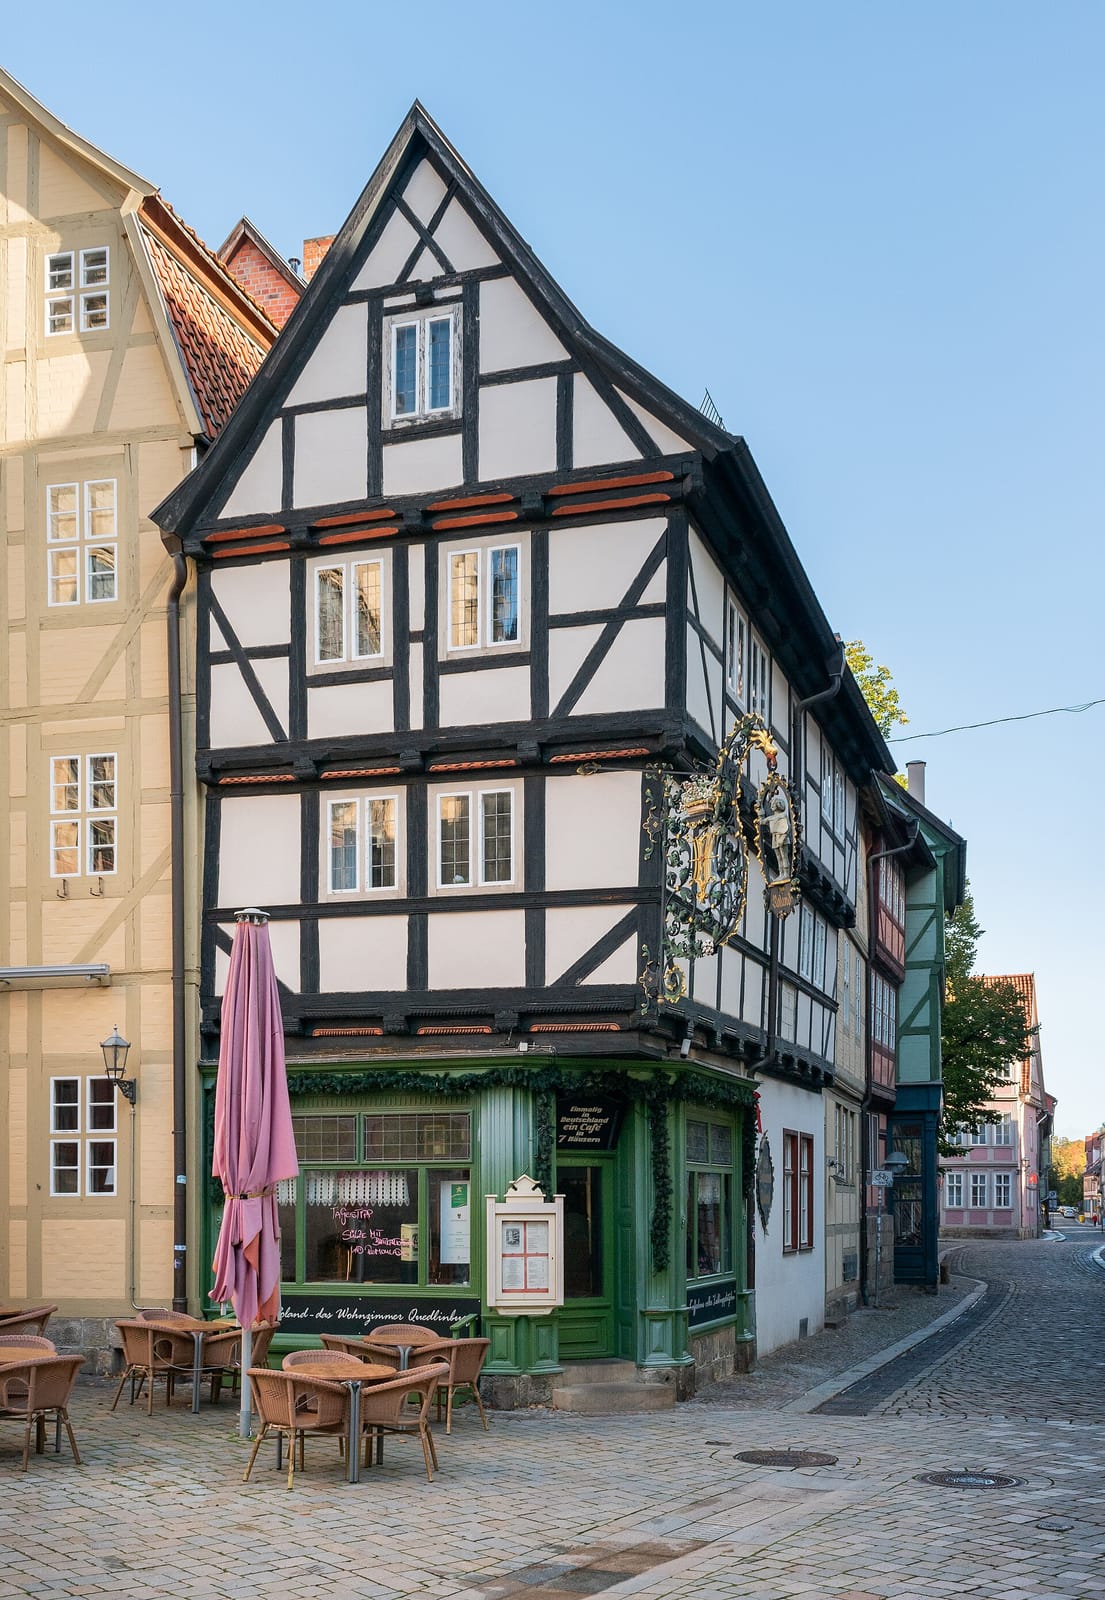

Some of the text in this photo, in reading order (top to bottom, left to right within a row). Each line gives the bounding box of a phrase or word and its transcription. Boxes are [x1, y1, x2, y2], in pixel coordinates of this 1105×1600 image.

[560, 1116, 609, 1124] Deutschland
[579, 1123, 601, 1133] Café
[558, 1135, 566, 1143] 7
[336, 1307, 404, 1326] Wohnzimmer
